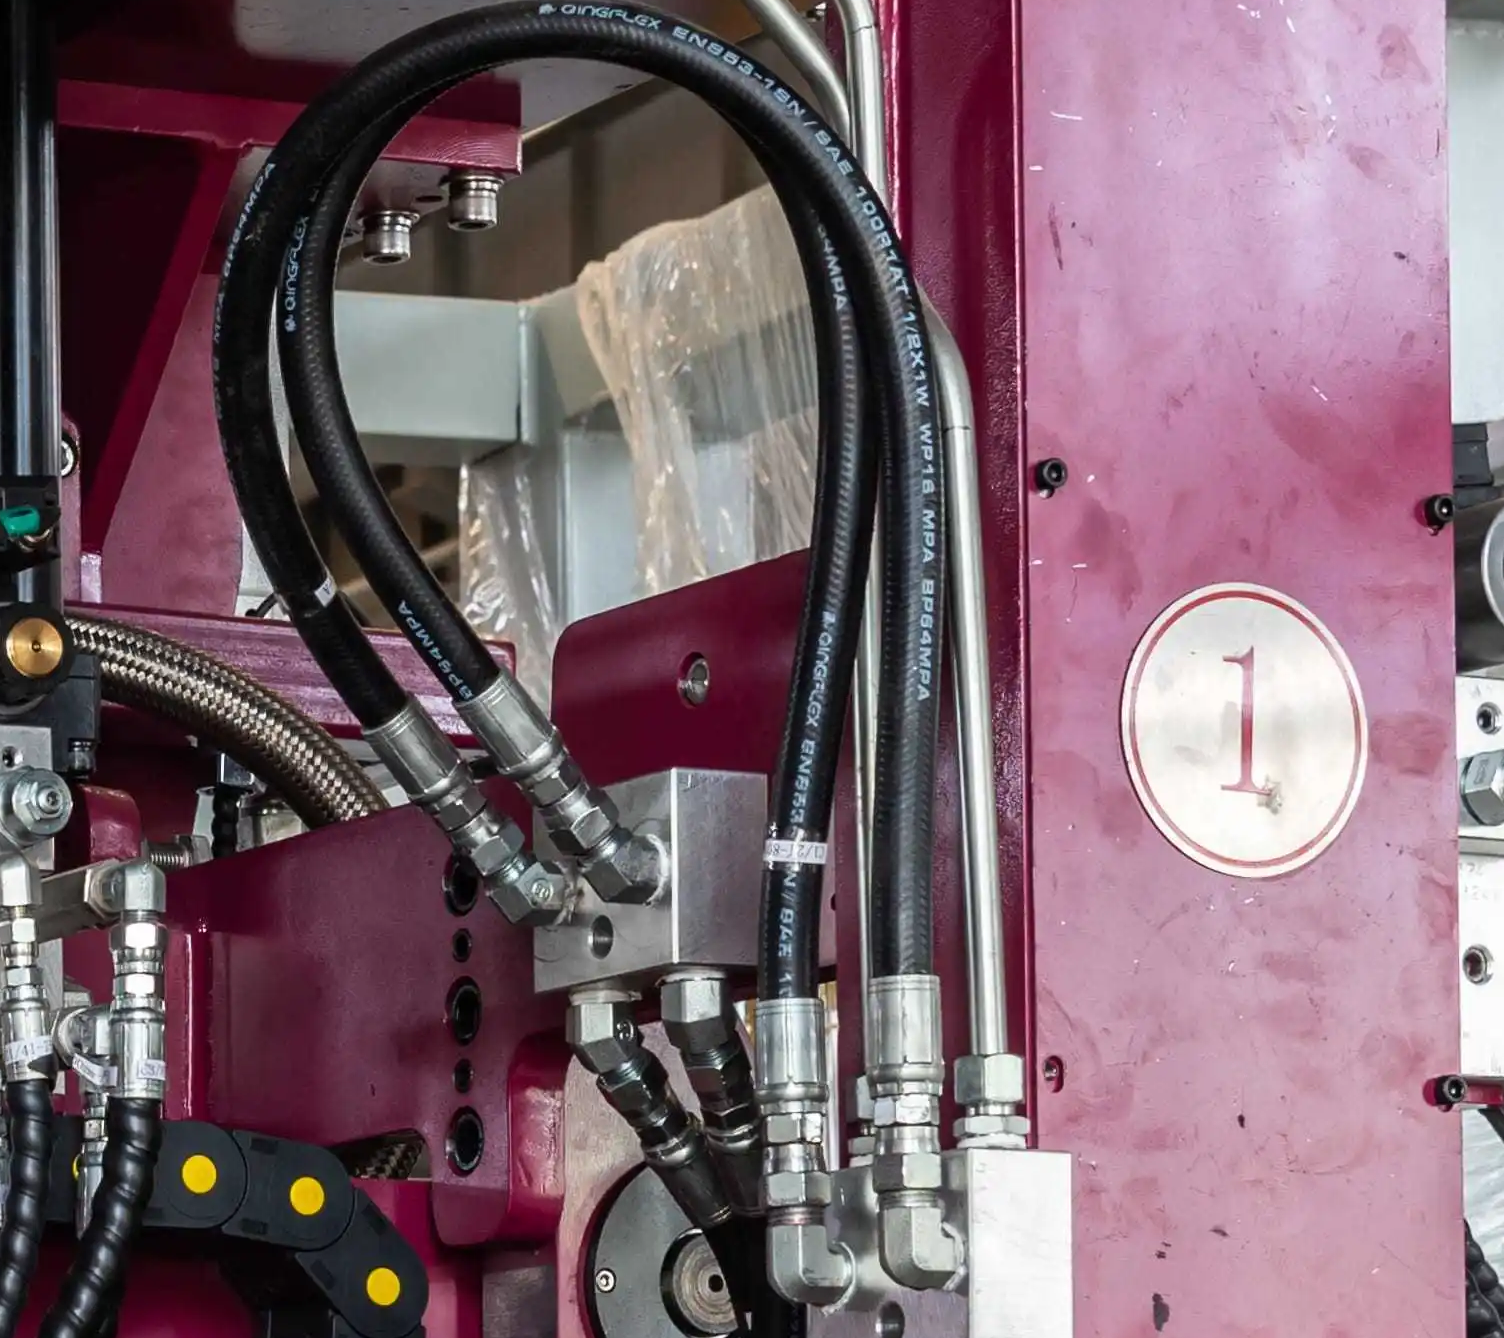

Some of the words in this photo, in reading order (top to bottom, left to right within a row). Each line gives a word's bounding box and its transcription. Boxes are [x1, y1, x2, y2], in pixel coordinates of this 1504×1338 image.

[560, 4, 662, 31] QINGFLEX
[921, 508, 937, 565] MPA
[1221, 645, 1273, 796] 1
